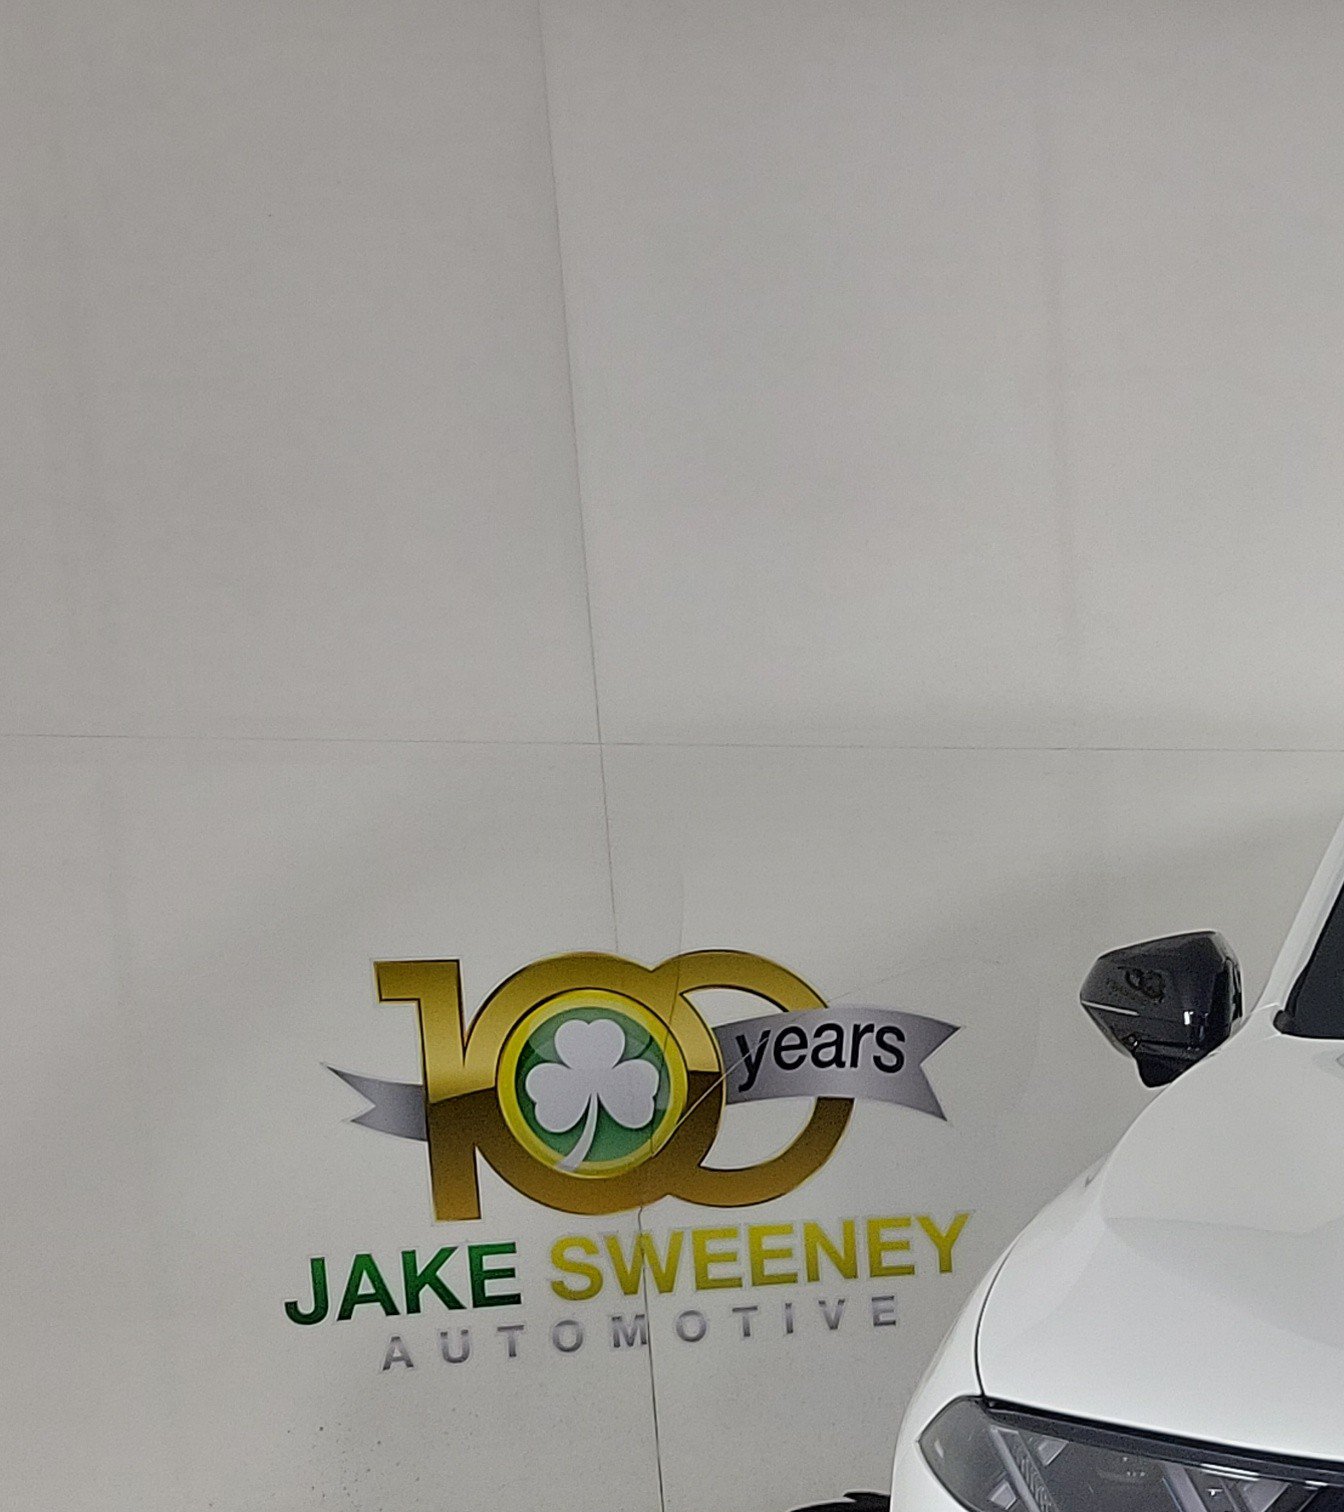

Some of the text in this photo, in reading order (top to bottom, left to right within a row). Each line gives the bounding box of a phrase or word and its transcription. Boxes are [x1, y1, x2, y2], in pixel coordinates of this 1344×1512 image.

[373, 950, 907, 1222] 100 years
[283, 1211, 971, 1327] JAKE SWEENEY
[381, 1295, 897, 1372] AUTOMOTIVE
